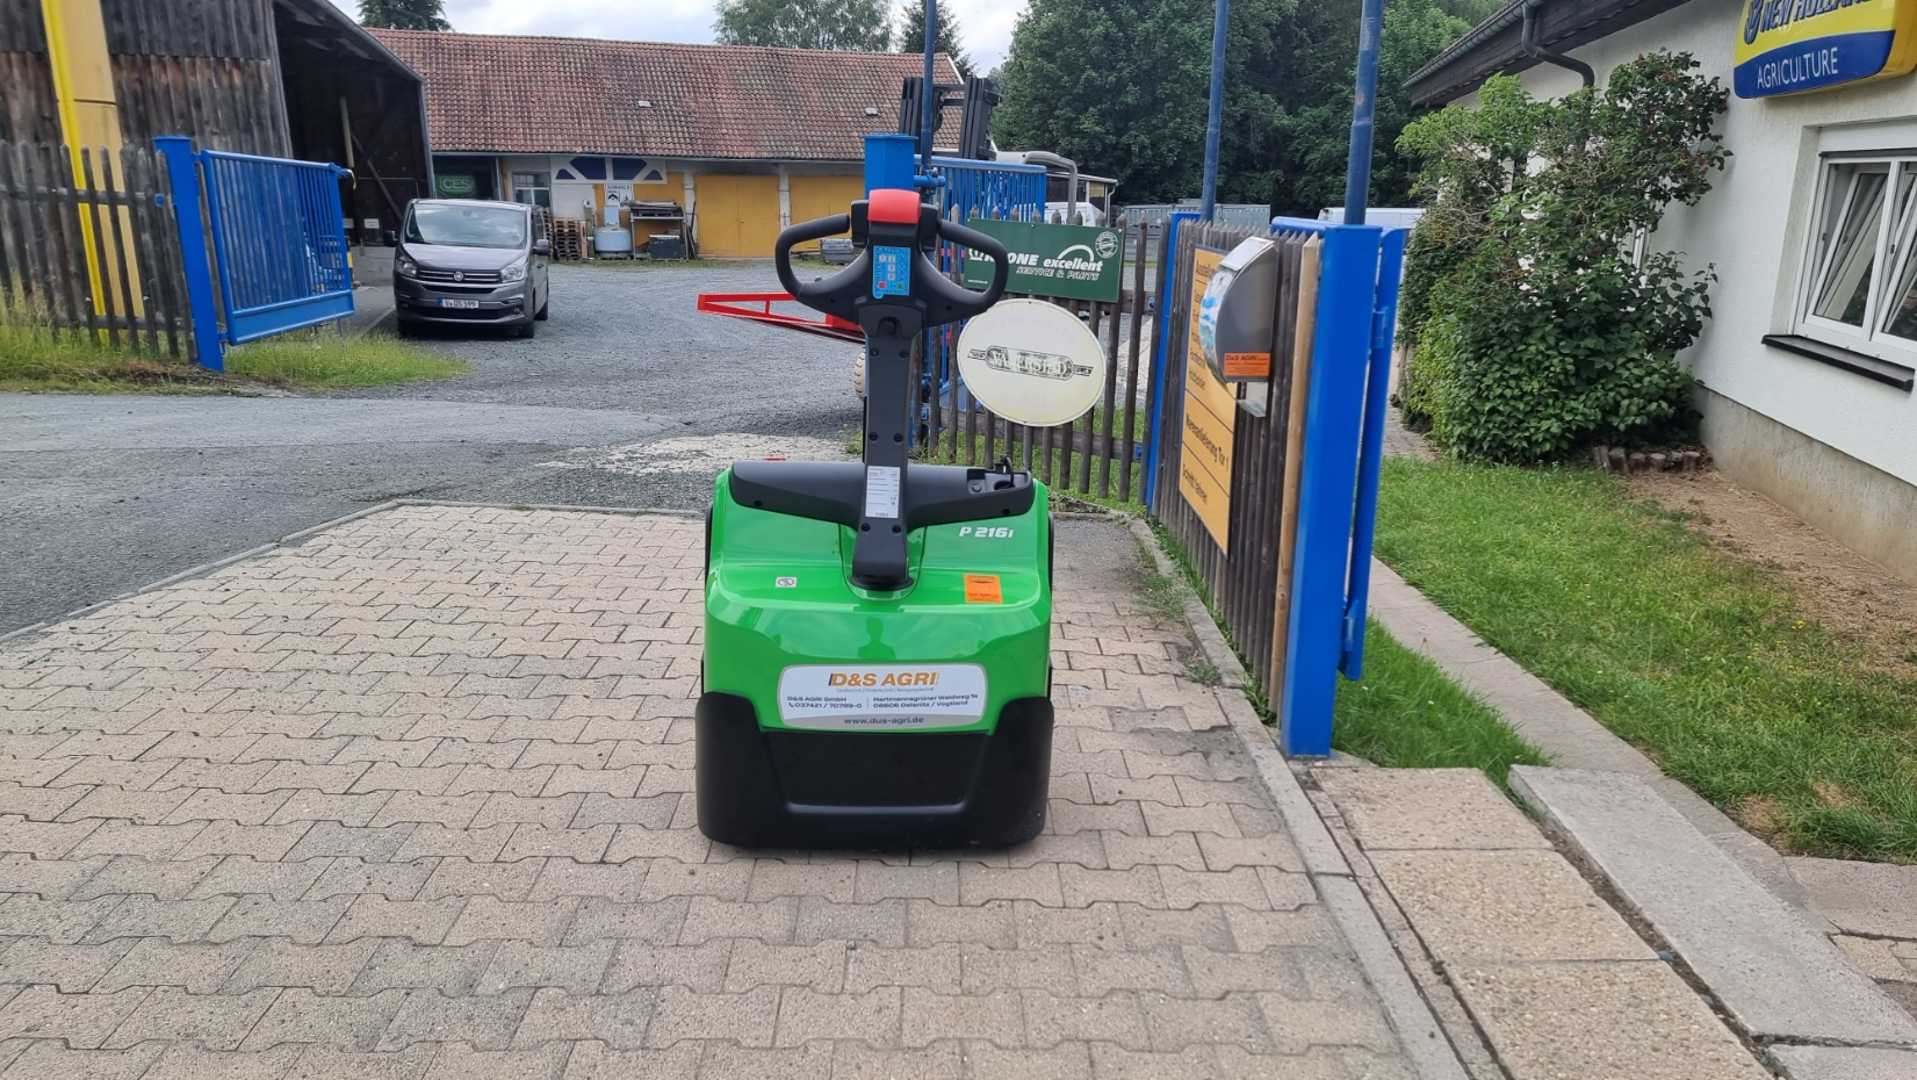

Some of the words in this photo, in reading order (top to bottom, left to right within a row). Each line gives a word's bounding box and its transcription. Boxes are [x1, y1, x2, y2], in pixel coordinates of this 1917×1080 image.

[1757, 47, 1839, 89] AGRICULTURE
[1043, 257, 1104, 272] excellent
[959, 526, 972, 537] P
[828, 673, 878, 687] D&S
[881, 672, 937, 686] AGRI
